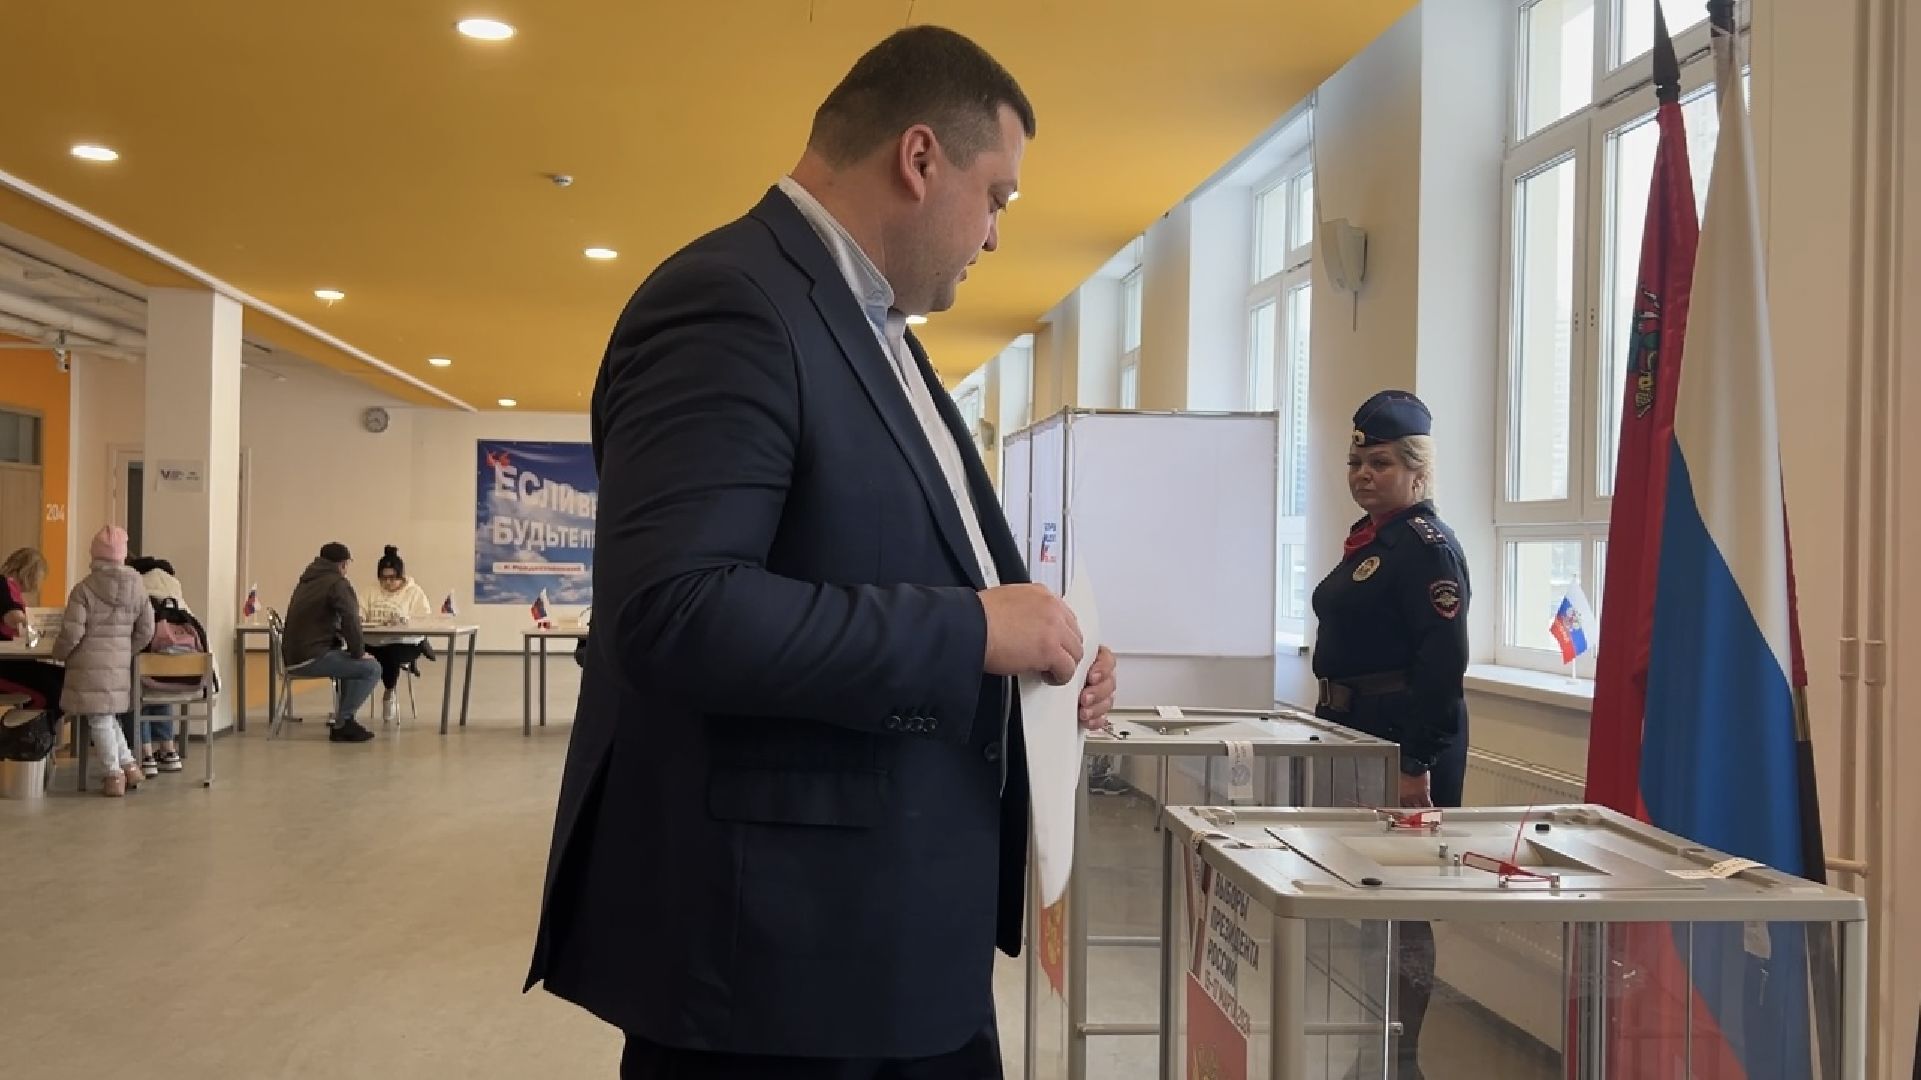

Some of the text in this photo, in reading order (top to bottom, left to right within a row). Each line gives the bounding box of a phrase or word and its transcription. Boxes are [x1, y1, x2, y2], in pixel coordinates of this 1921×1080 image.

[46, 503, 65, 521] 204
[494, 461, 574, 514] ЕСЛИ
[493, 516, 578, 550] БУДЬТЕ
[1213, 872, 1250, 921] ВЫБОРЫ
[1210, 905, 1259, 971] ПРЕЗИДЕНТА
[1207, 938, 1238, 988] РОССИИ
